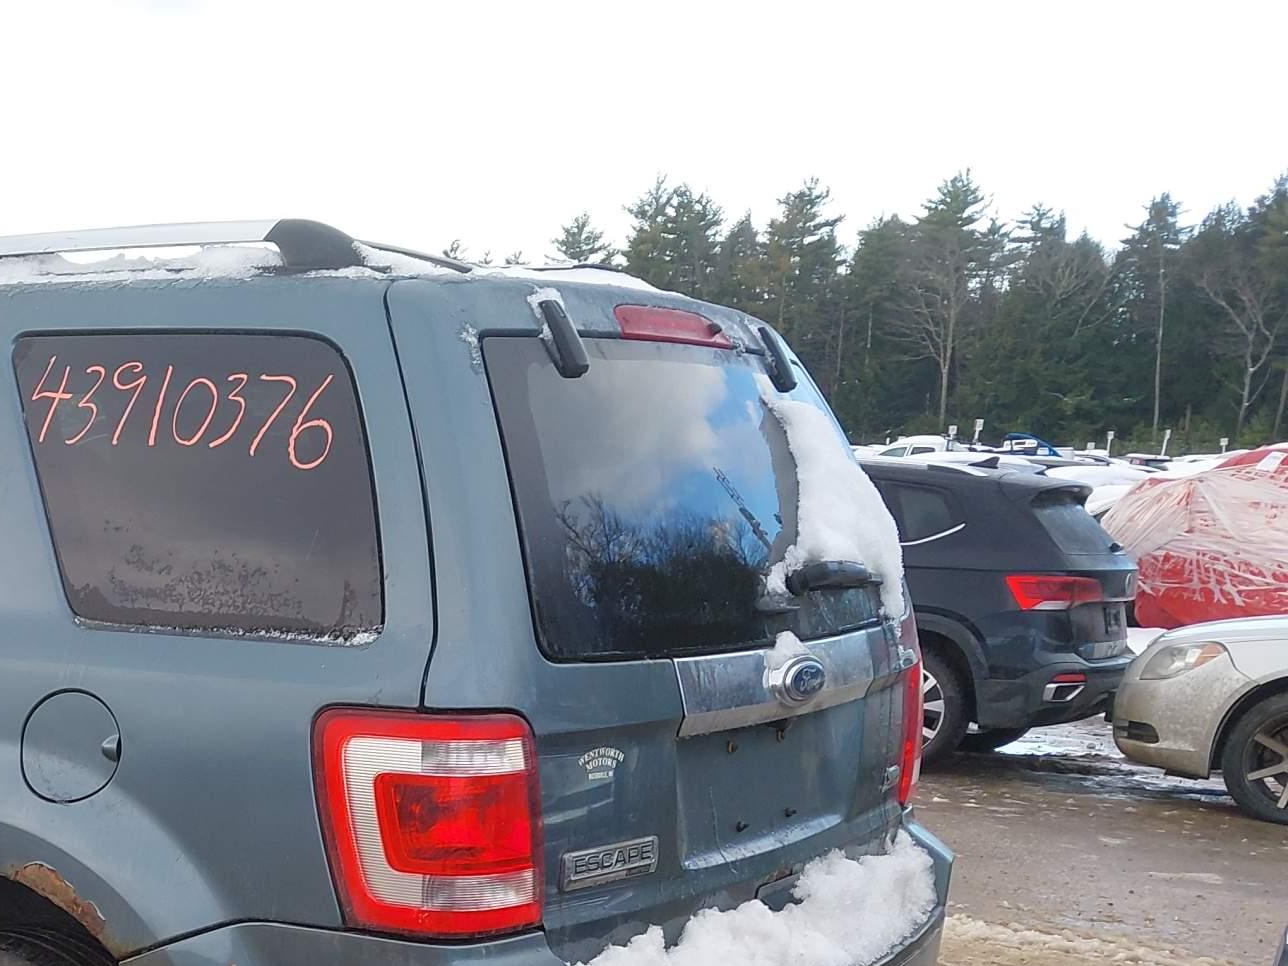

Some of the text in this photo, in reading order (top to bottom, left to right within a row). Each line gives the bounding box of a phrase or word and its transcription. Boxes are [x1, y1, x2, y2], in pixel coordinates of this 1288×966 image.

[31, 356, 334, 470] 43910376
[578, 747, 624, 766] WENTWORTH
[585, 757, 616, 770] MOTORS
[573, 843, 652, 874] ESCAPE
